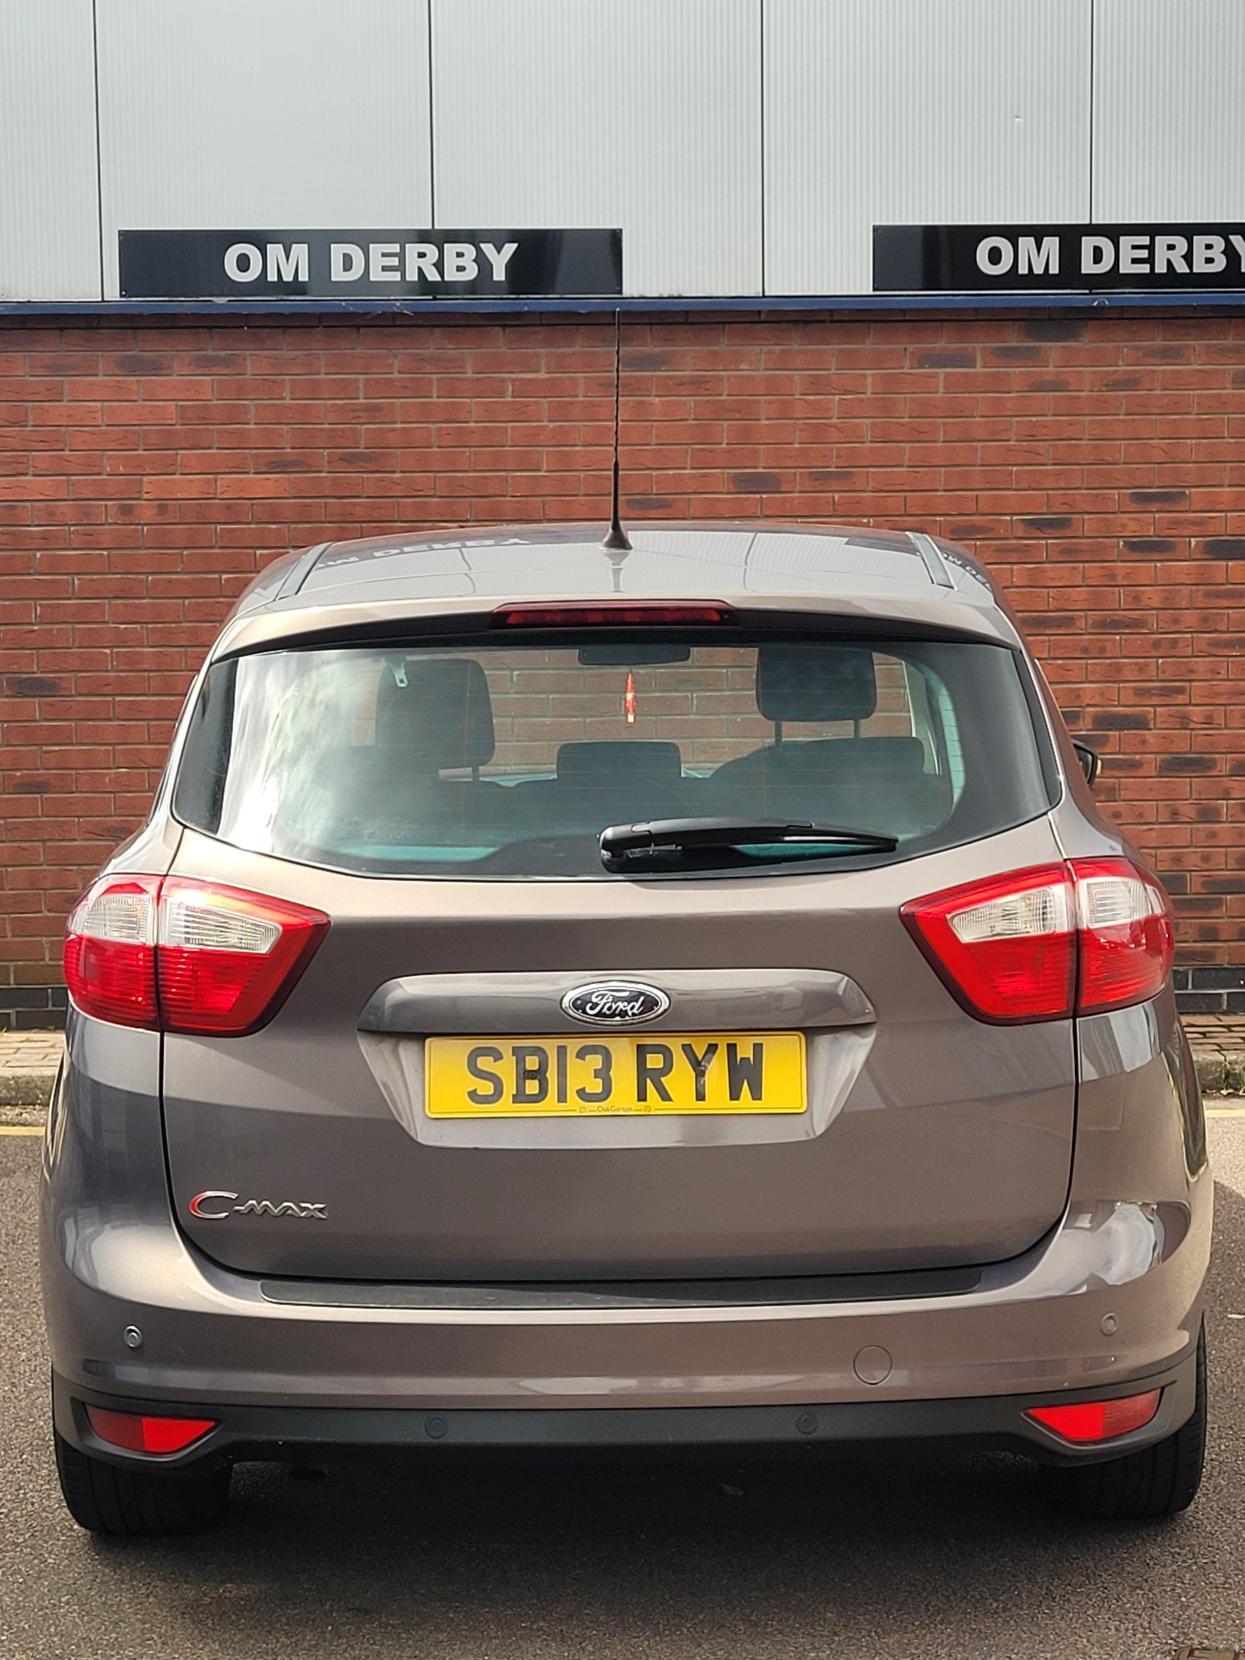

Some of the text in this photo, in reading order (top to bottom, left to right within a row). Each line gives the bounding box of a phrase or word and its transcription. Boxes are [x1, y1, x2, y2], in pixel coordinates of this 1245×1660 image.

[224, 243, 518, 283] OM DERBY
[976, 235, 1245, 274] OM DERBY
[585, 991, 642, 1015] Ford
[467, 1043, 763, 1104] SB13 RYW
